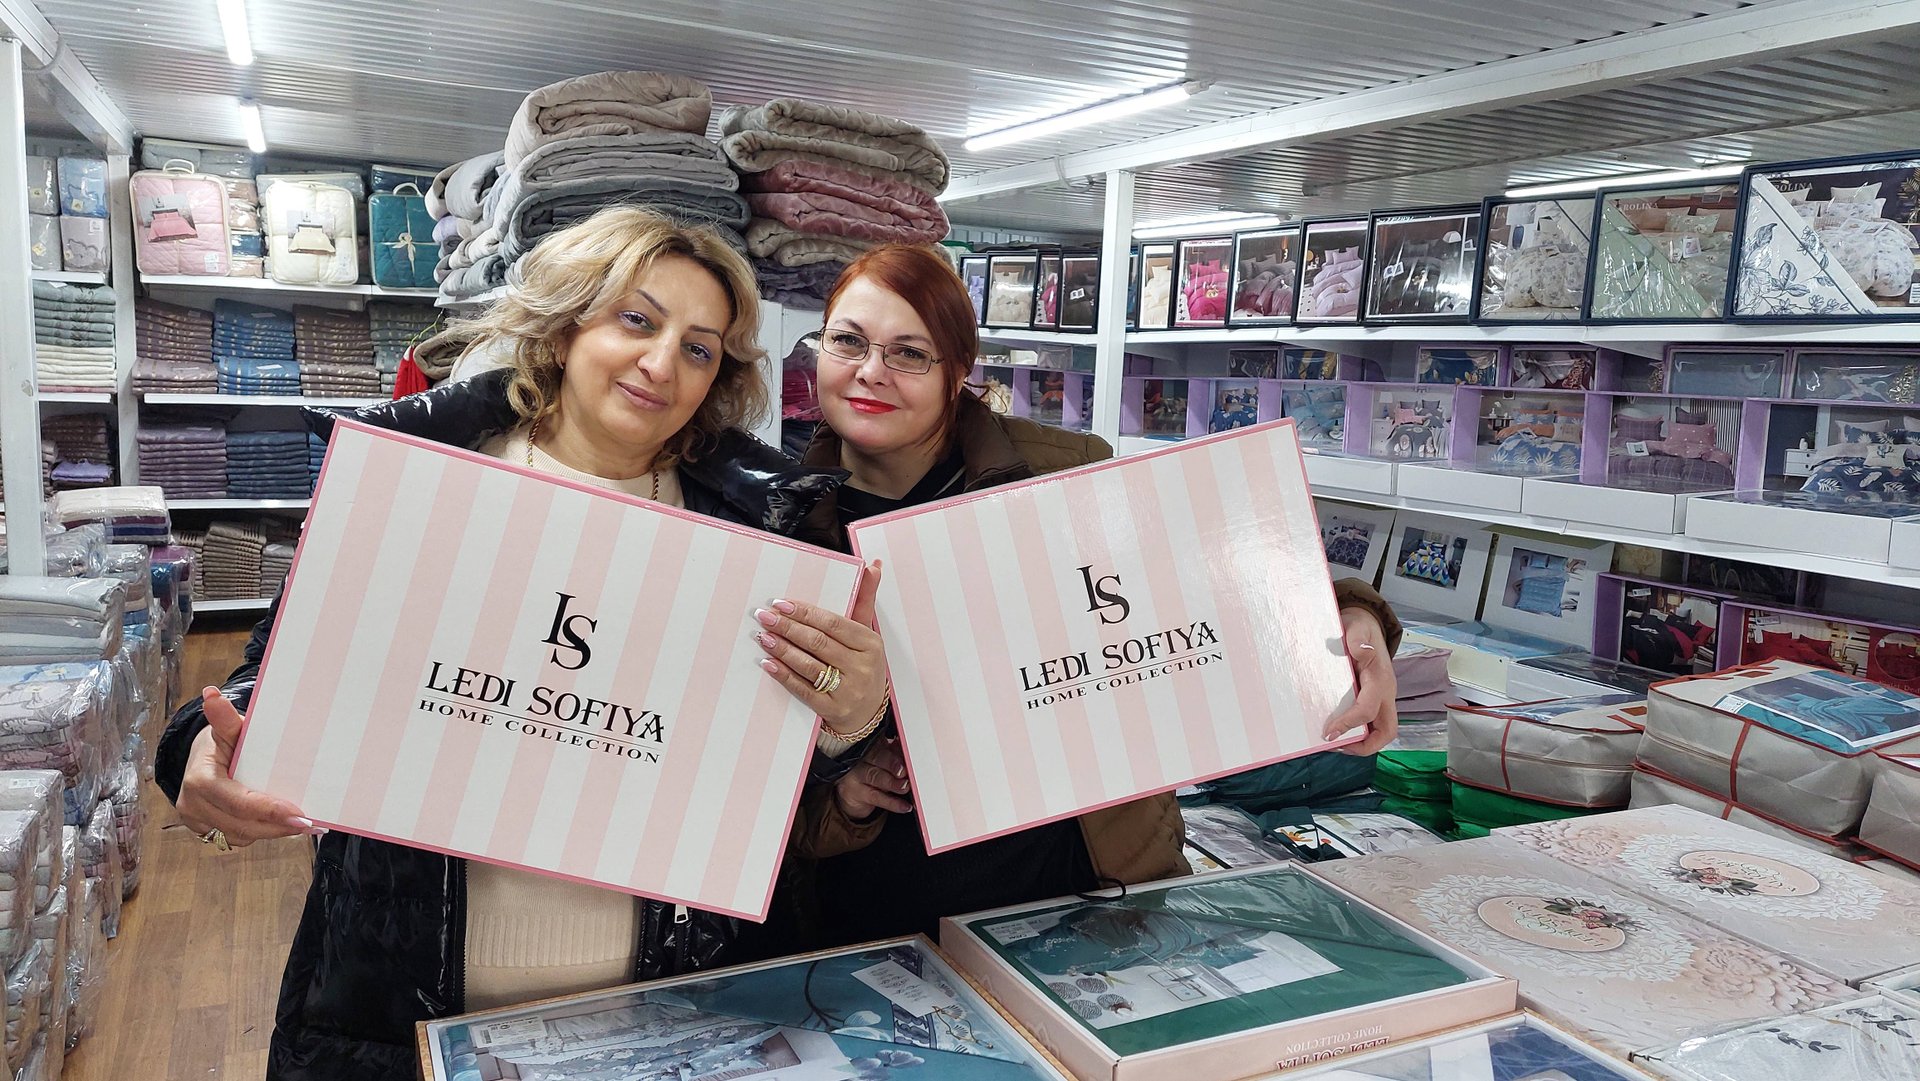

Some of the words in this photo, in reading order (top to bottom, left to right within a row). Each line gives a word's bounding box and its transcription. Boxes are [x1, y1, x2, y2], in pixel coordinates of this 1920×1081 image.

[1076, 564, 1131, 626] LS
[541, 591, 598, 670] LS
[1019, 652, 1092, 692] LEDI
[1102, 621, 1219, 671] SOFIYA
[425, 661, 517, 708] LEDI
[526, 686, 665, 744] SOFIYA
[1026, 686, 1087, 710] HOME
[1095, 652, 1224, 692] COLLECTION
[418, 699, 494, 726] HOME
[504, 720, 660, 764] COLLECTION
[1286, 1032, 1351, 1055] COLLECTION
[1354, 1025, 1382, 1036] HOME
